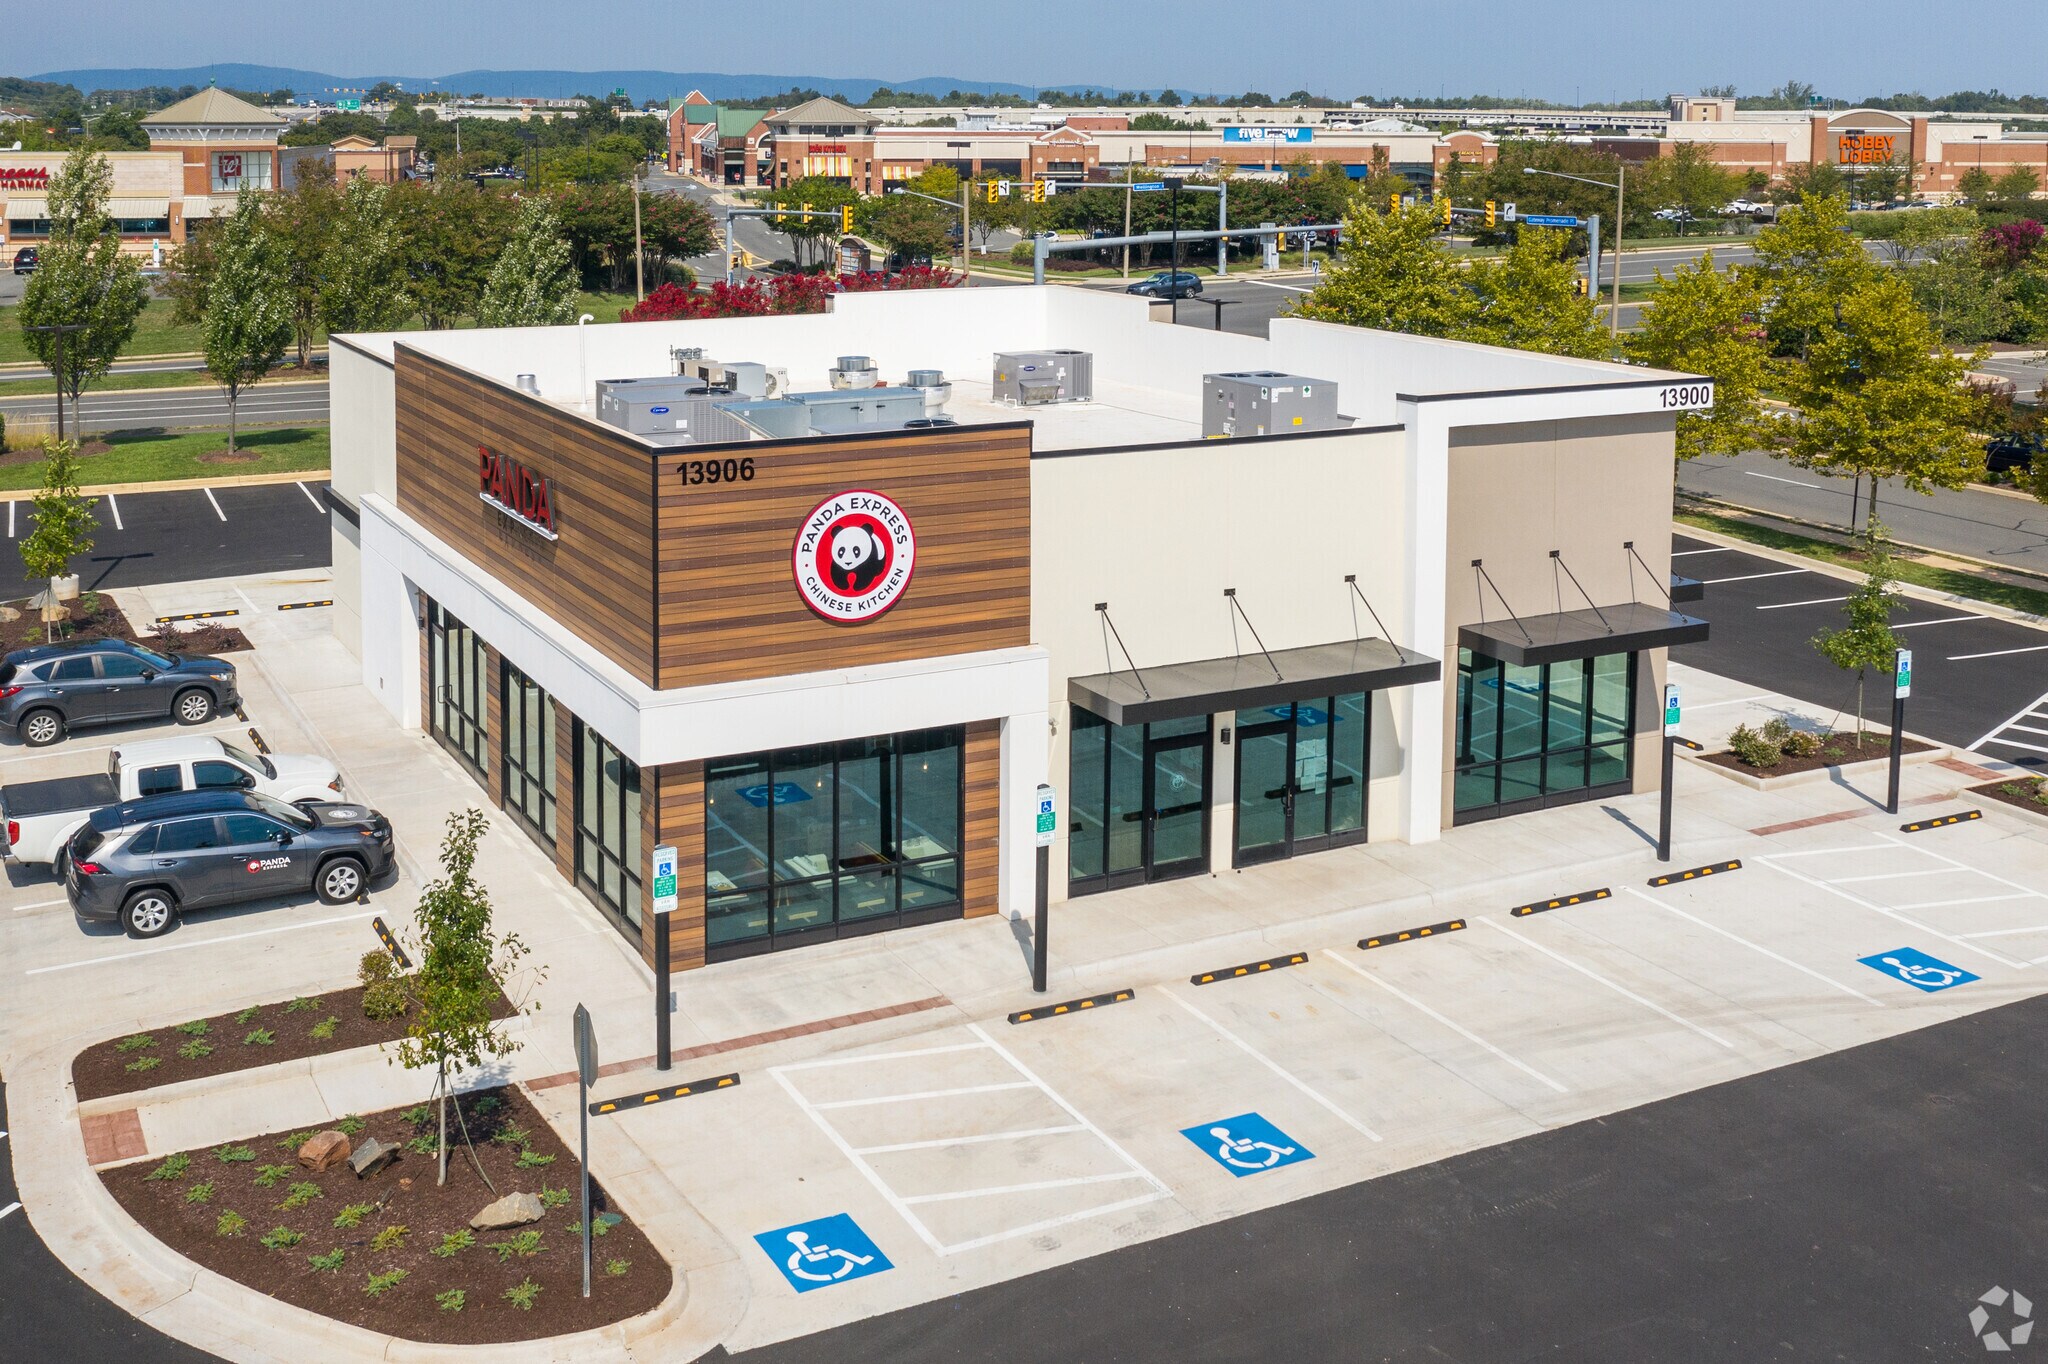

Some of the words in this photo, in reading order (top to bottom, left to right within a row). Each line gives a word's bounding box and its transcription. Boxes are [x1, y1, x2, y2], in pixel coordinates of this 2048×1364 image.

[1839, 135, 1896, 149] HOBBY
[1840, 149, 1895, 164] LOBBY
[1660, 386, 1710, 408] 13900
[676, 458, 755, 486] 13906
[479, 445, 555, 532] PANDA
[802, 502, 845, 553] PANDA
[850, 497, 908, 545] EXPRESS
[806, 576, 852, 612] CHINESE
[858, 568, 904, 611] KITCHEN
[260, 857, 291, 867] PANDA
